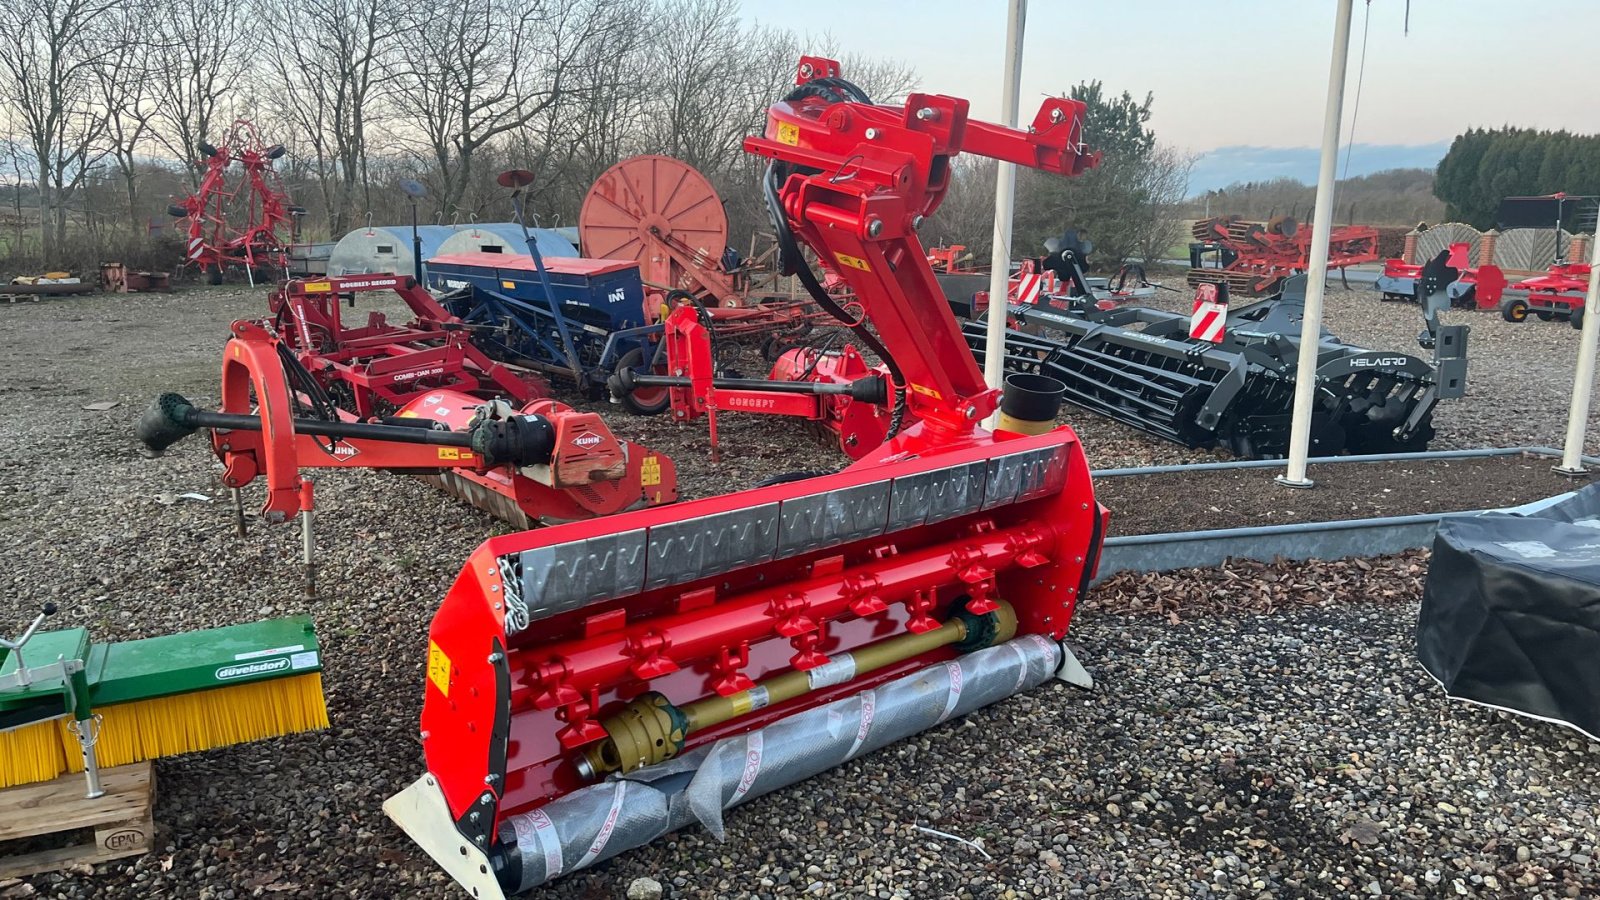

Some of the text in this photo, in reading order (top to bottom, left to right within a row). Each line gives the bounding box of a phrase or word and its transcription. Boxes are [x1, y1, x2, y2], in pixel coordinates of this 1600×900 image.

[1350, 357, 1407, 367] HELAGRO
[729, 397, 775, 408] CONCEPT
[576, 436, 600, 446] KUHN
[328, 446, 355, 456] UHN
[219, 659, 287, 678] düvelsdorf
[111, 833, 138, 848] EPAL
